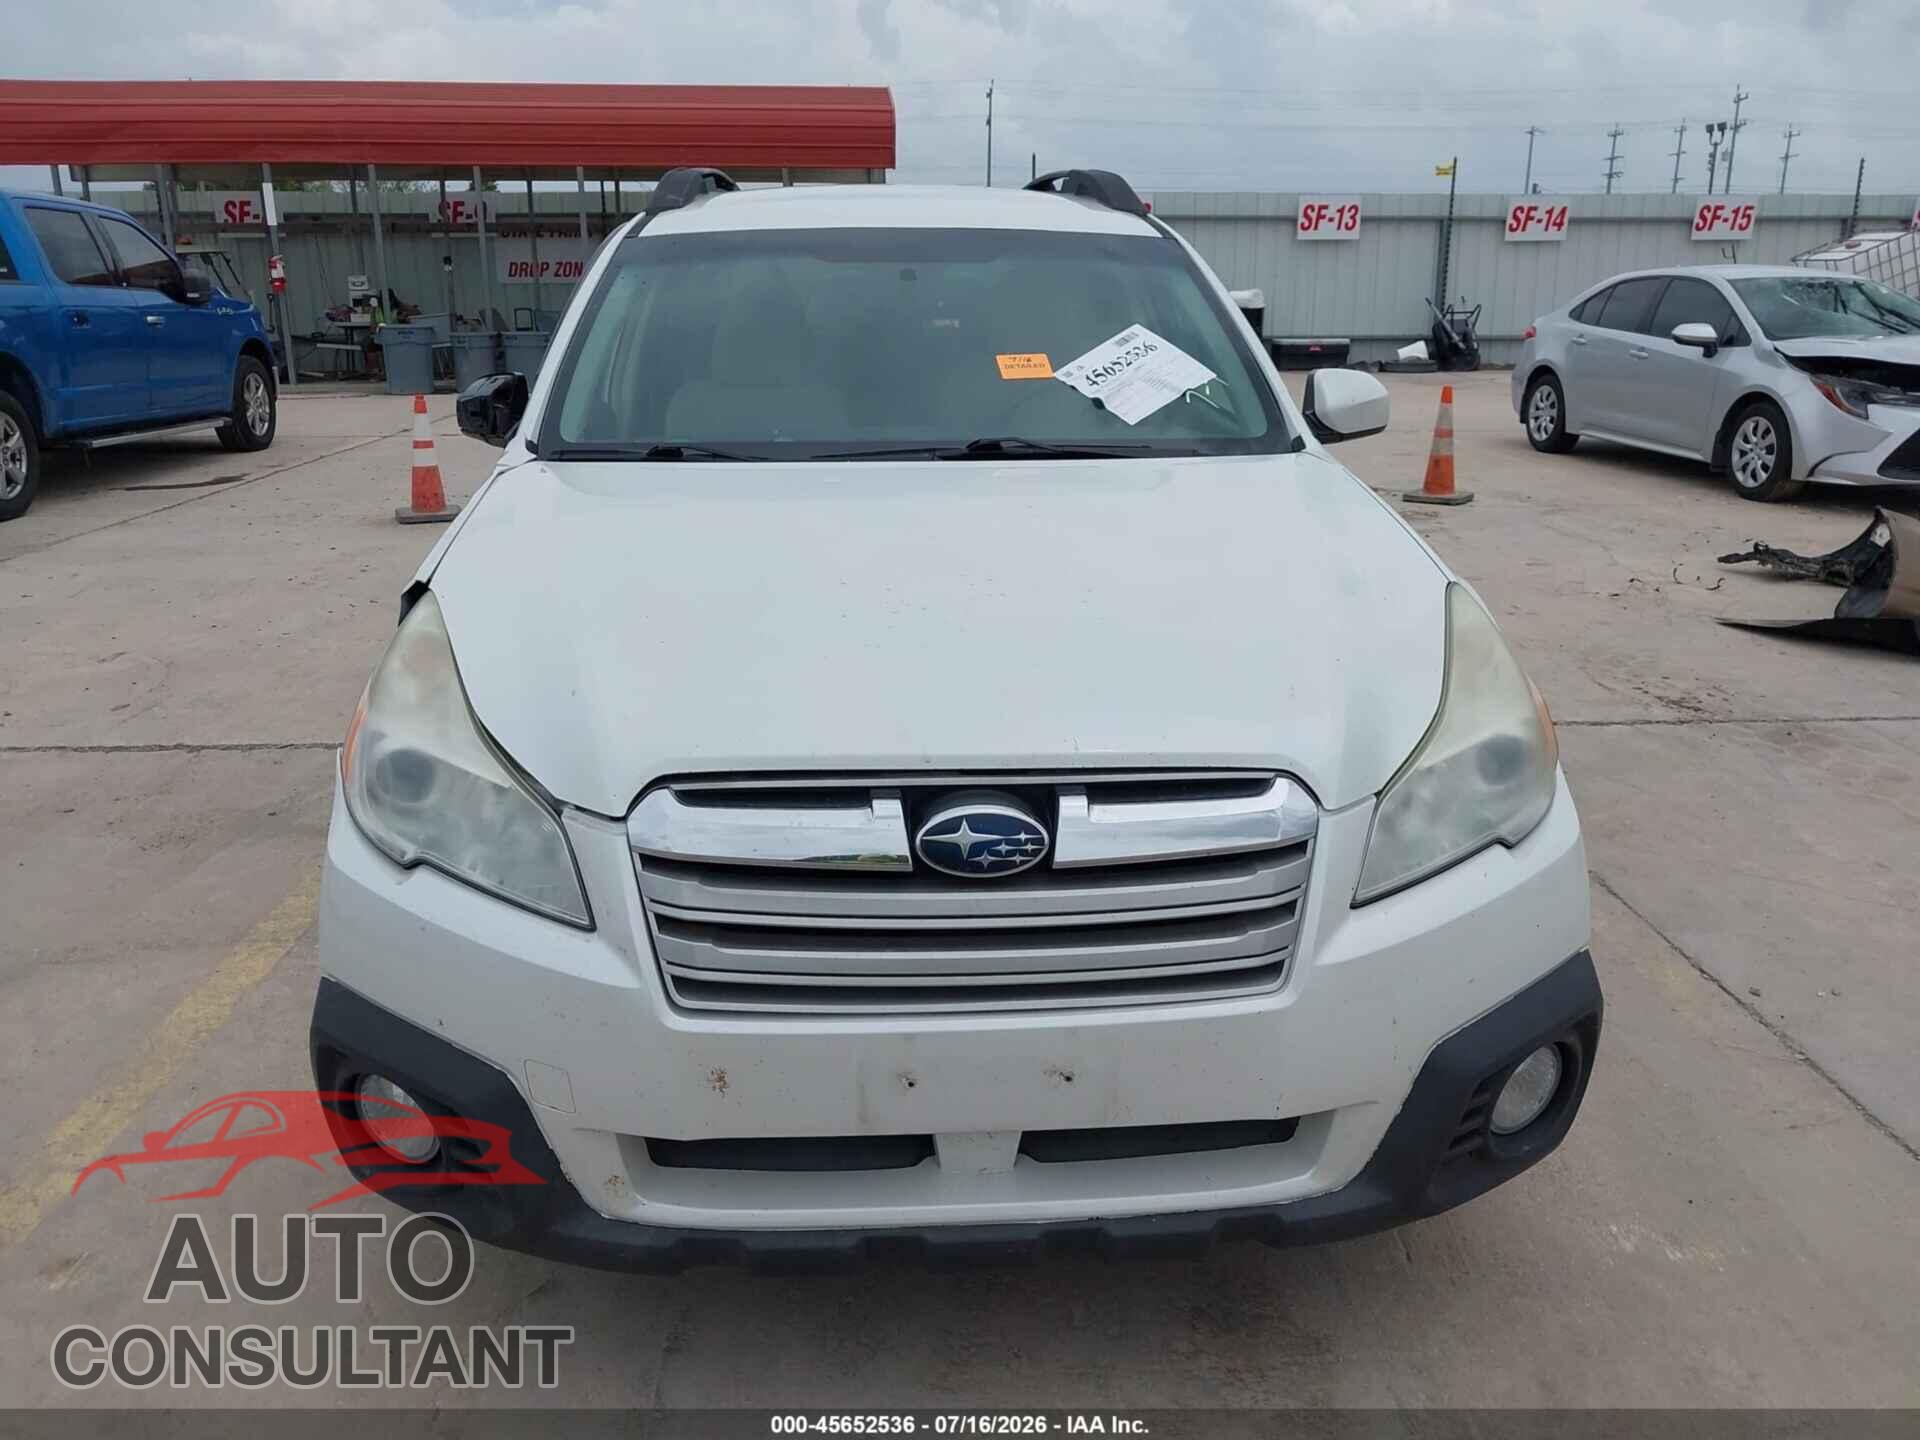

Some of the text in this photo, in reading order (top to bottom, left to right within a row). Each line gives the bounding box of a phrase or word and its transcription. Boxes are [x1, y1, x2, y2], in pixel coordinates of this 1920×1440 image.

[224, 200, 265, 224] SF-
[1300, 204, 1360, 231] SF-13
[1508, 205, 1568, 233] SF-14
[1695, 204, 1755, 231] SF-15
[553, 261, 584, 277] ZON
